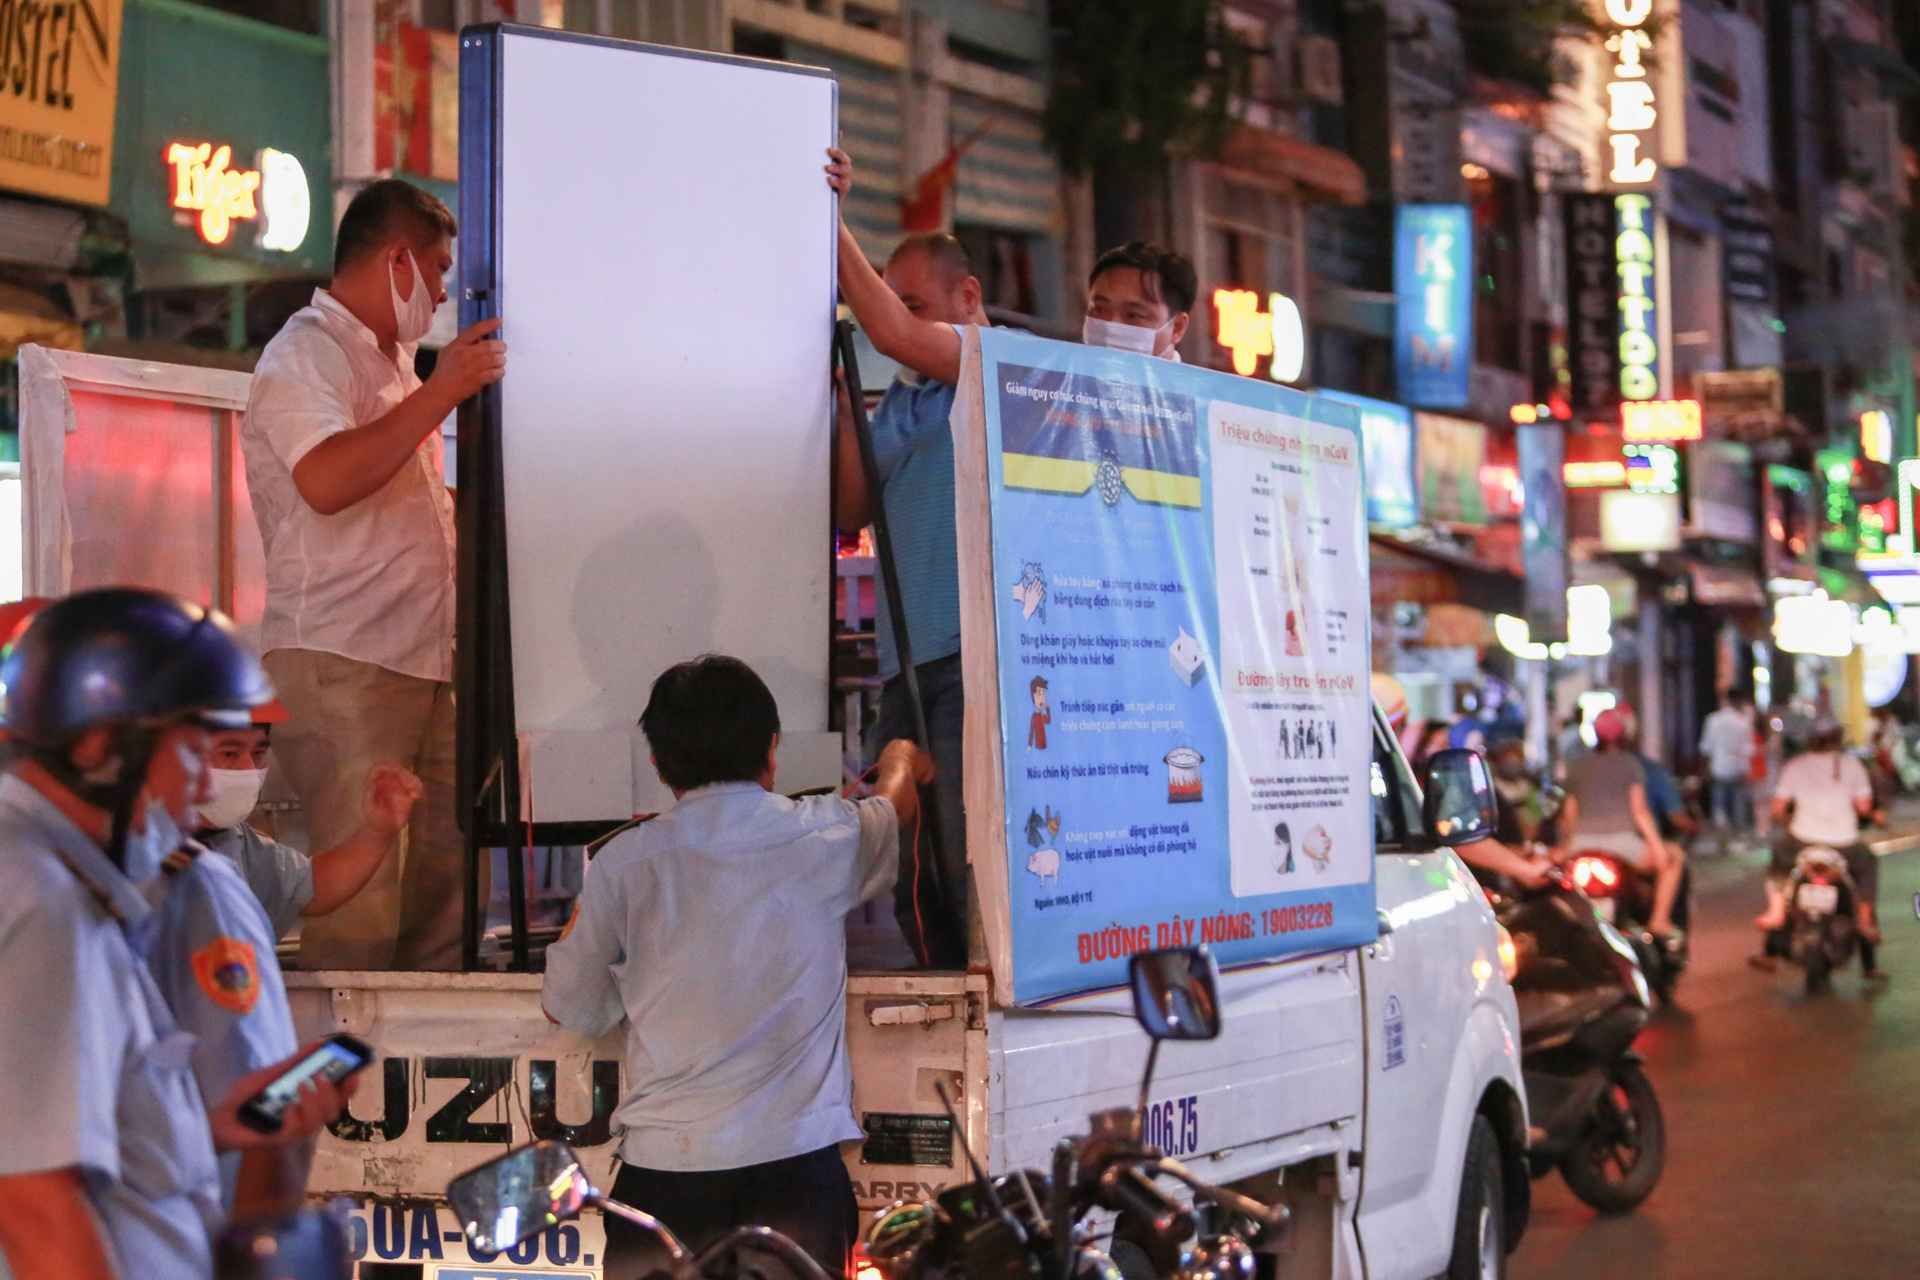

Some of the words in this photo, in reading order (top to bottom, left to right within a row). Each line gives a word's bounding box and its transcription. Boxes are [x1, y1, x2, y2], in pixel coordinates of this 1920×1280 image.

[167, 142, 261, 244] Tiger
[1028, 388, 1047, 401] nguy
[1221, 421, 1250, 443] Triệu
[1253, 428, 1286, 451] chứng
[1324, 444, 1348, 460] nCoV
[1056, 653, 1068, 665] khi
[1069, 654, 1078, 665] ho
[1238, 671, 1274, 690] Đường
[1078, 922, 1150, 964] ĐƯỜNG
[1157, 915, 1195, 949] DÂY
[1202, 910, 1255, 944] NÓNG:
[1262, 902, 1333, 936] 19003228
